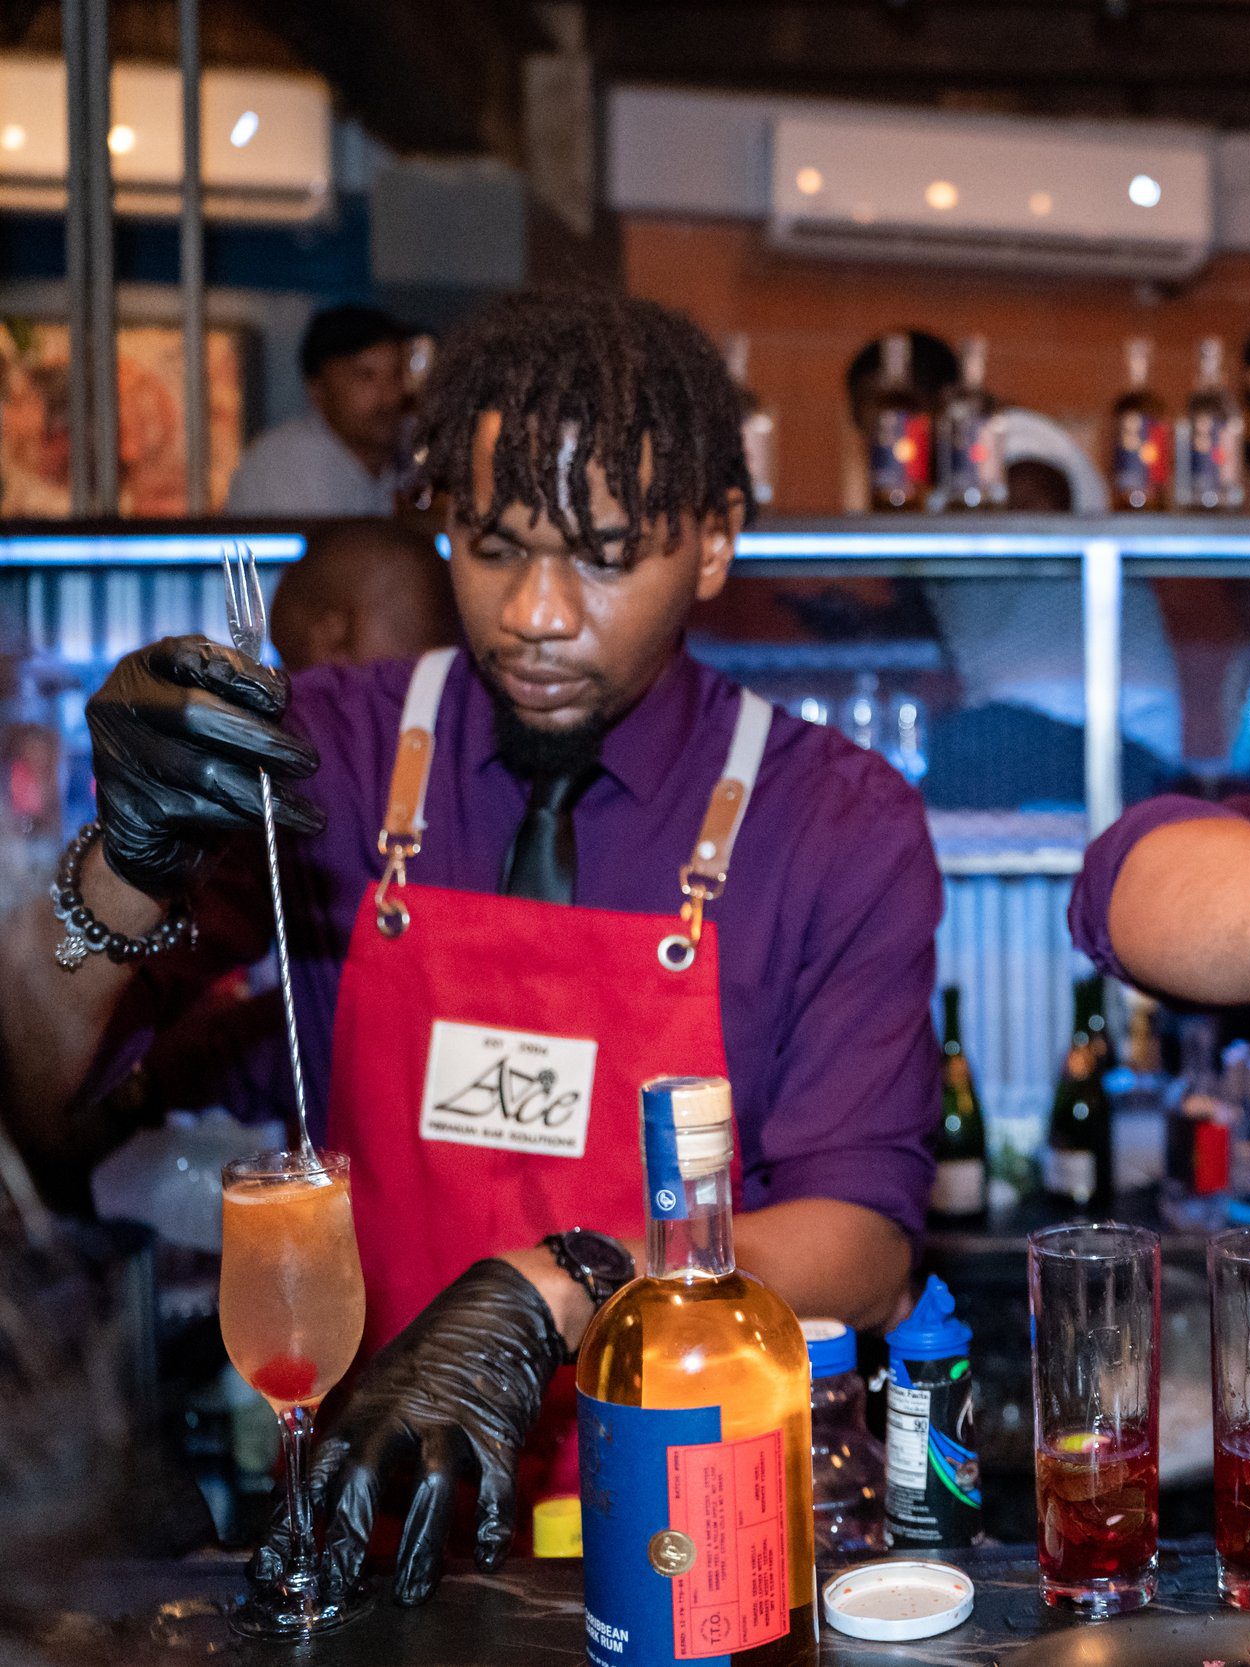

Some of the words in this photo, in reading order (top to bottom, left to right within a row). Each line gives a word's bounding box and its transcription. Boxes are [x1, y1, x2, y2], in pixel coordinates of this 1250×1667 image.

[434, 1055, 580, 1128] Ace
[585, 1608, 629, 1642] ARIBBEAN
[586, 1620, 599, 1643] ARK
[601, 1635, 623, 1653] RUM
[710, 1612, 720, 1645] T.T.O.
